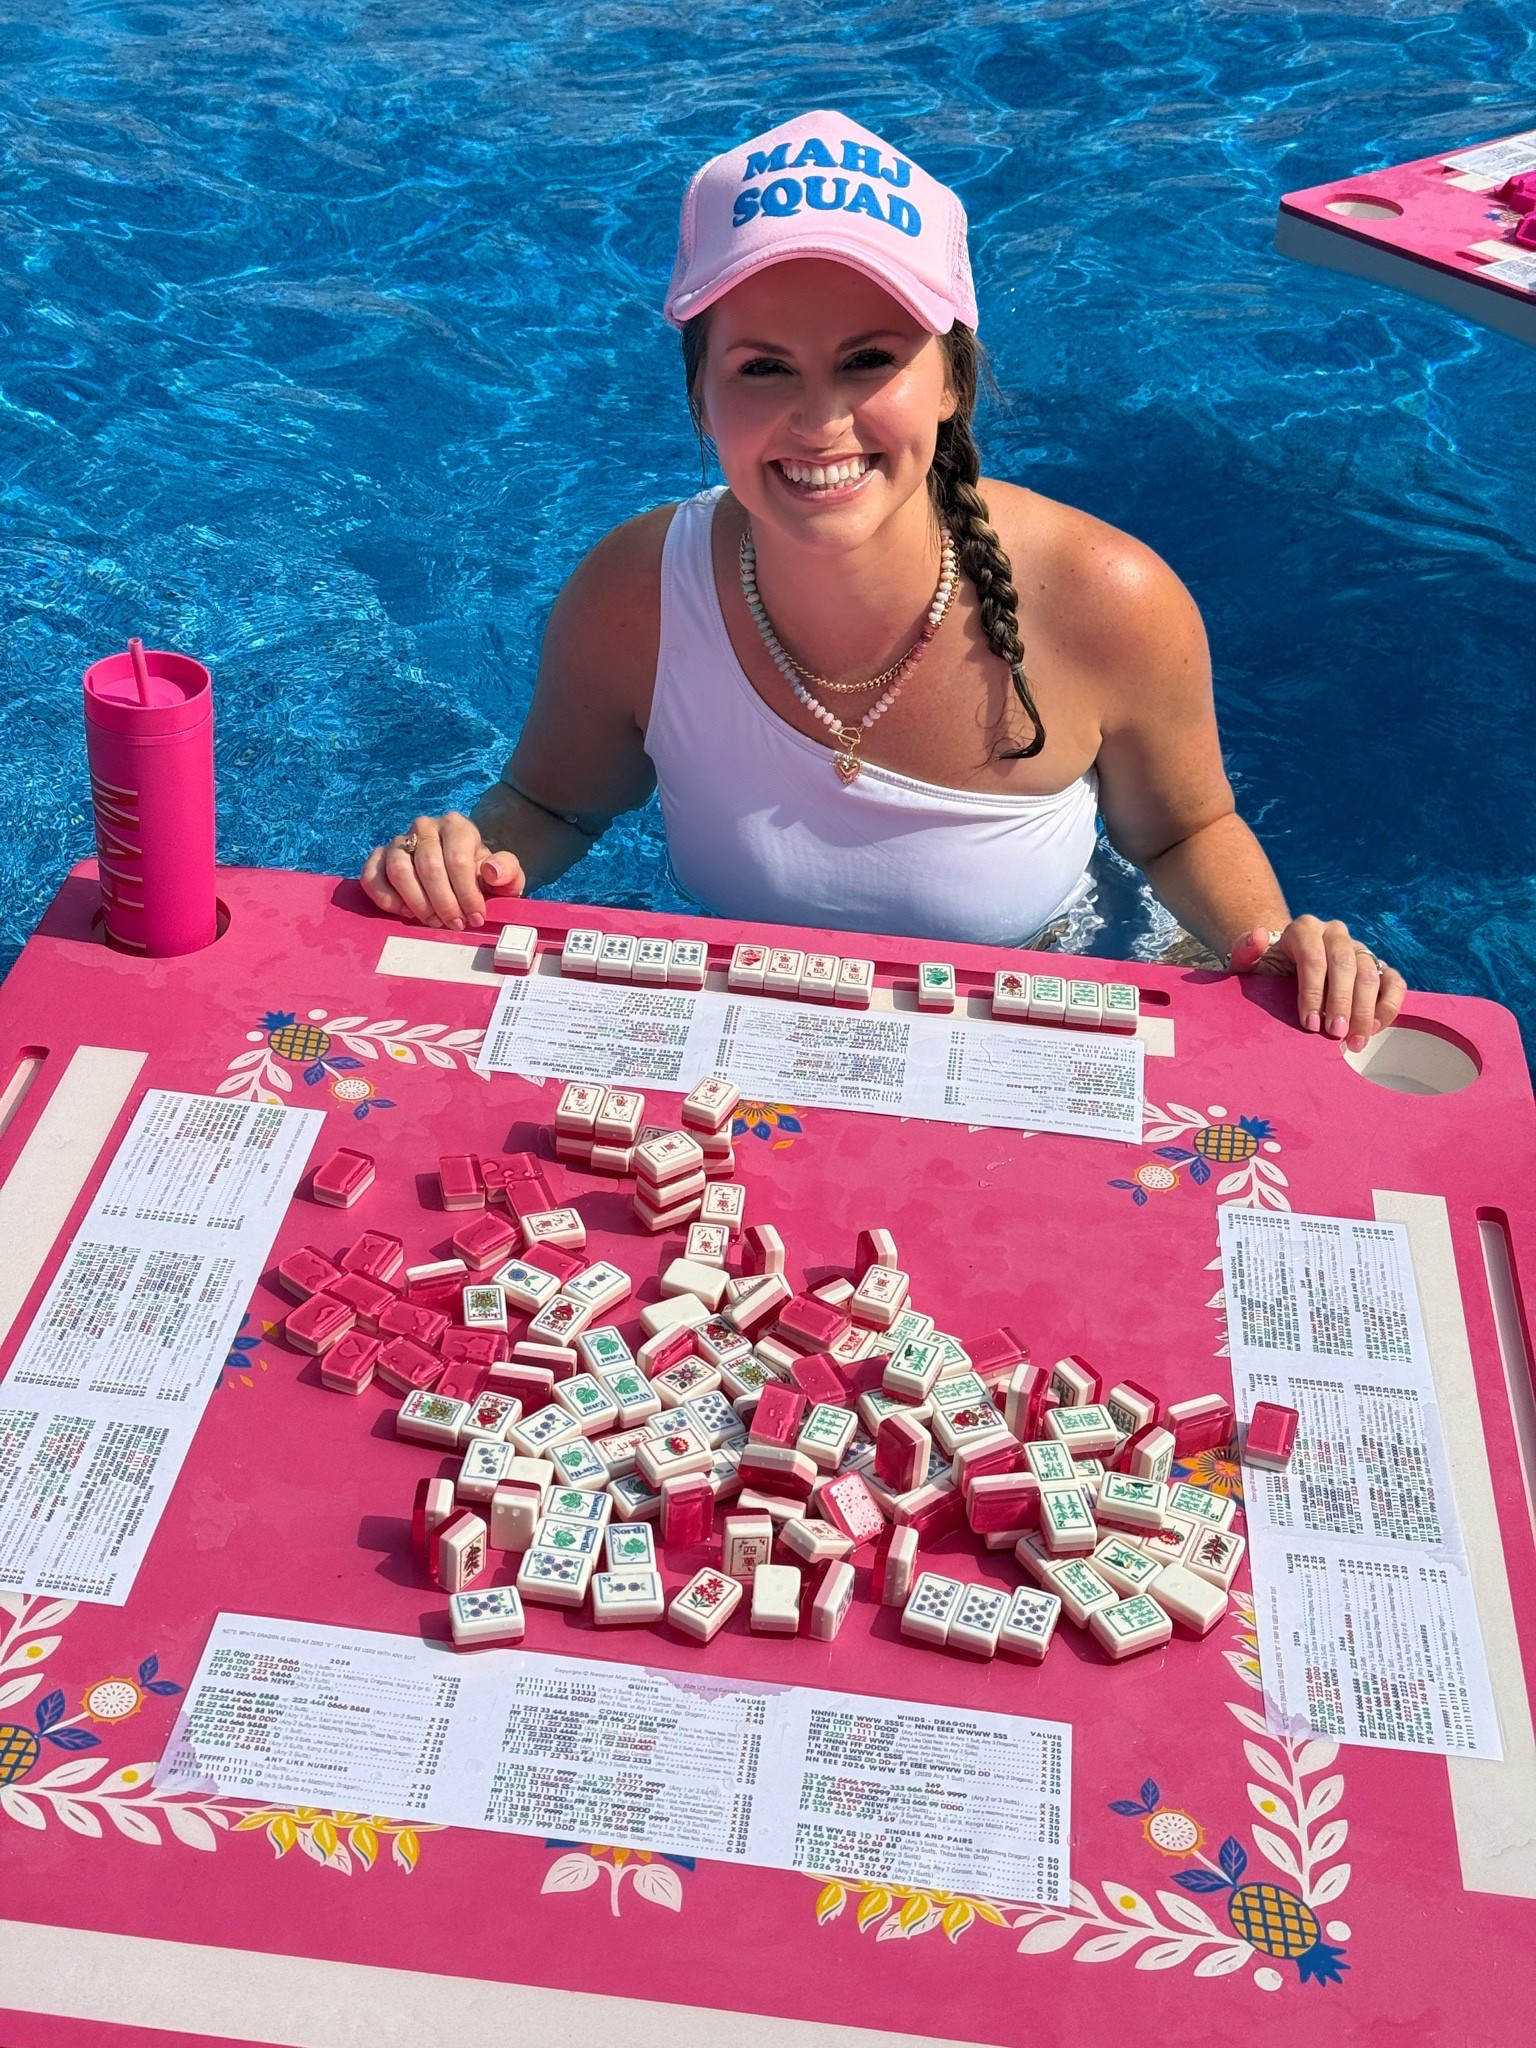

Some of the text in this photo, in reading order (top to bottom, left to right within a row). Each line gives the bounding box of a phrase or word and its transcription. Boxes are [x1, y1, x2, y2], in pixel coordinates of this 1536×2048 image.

[743, 138, 912, 188] MAHJ
[732, 176, 922, 237] SQUAD
[539, 1319, 569, 1333] Joker
[718, 1337, 746, 1352] Joker
[600, 1352, 626, 1365] East
[726, 1355, 752, 1371] Joker
[408, 1392, 425, 1417] Joker
[485, 1395, 514, 1407] Joker
[622, 1392, 651, 1406] West
[582, 1400, 608, 1414] East
[569, 1462, 602, 1480] North
[590, 1492, 606, 1521] South
[130, 1508, 145, 1536] DRAGONS
[611, 1526, 646, 1536] North
[581, 1525, 596, 1553] North
[1286, 1552, 1294, 1575] VALUES
[103, 1573, 118, 1596] VALUES
[1419, 1624, 1431, 1656] NUMBERS
[235, 1658, 256, 1667] DDD
[280, 1665, 301, 1673] DDD
[270, 1677, 296, 1686] NEWS
[432, 1674, 462, 1683] VALUES
[627, 1684, 659, 1693] QUINTS
[734, 1697, 766, 1706] VALUES
[598, 1708, 658, 1722] CONSECUTIVE
[897, 1714, 925, 1723] WINDS
[934, 1718, 977, 1729] DRAGONS
[832, 1718, 852, 1727] DDD
[853, 1721, 873, 1729] DDD
[874, 1724, 899, 1733] DDDD
[1030, 1731, 1062, 1741] VALUES
[306, 1761, 349, 1772] NUMBERS
[868, 1764, 896, 1773] WWW
[933, 1772, 945, 1780] Any
[554, 1823, 576, 1832] DDD
[884, 1827, 973, 1845] SINGLES AND PAIRS
